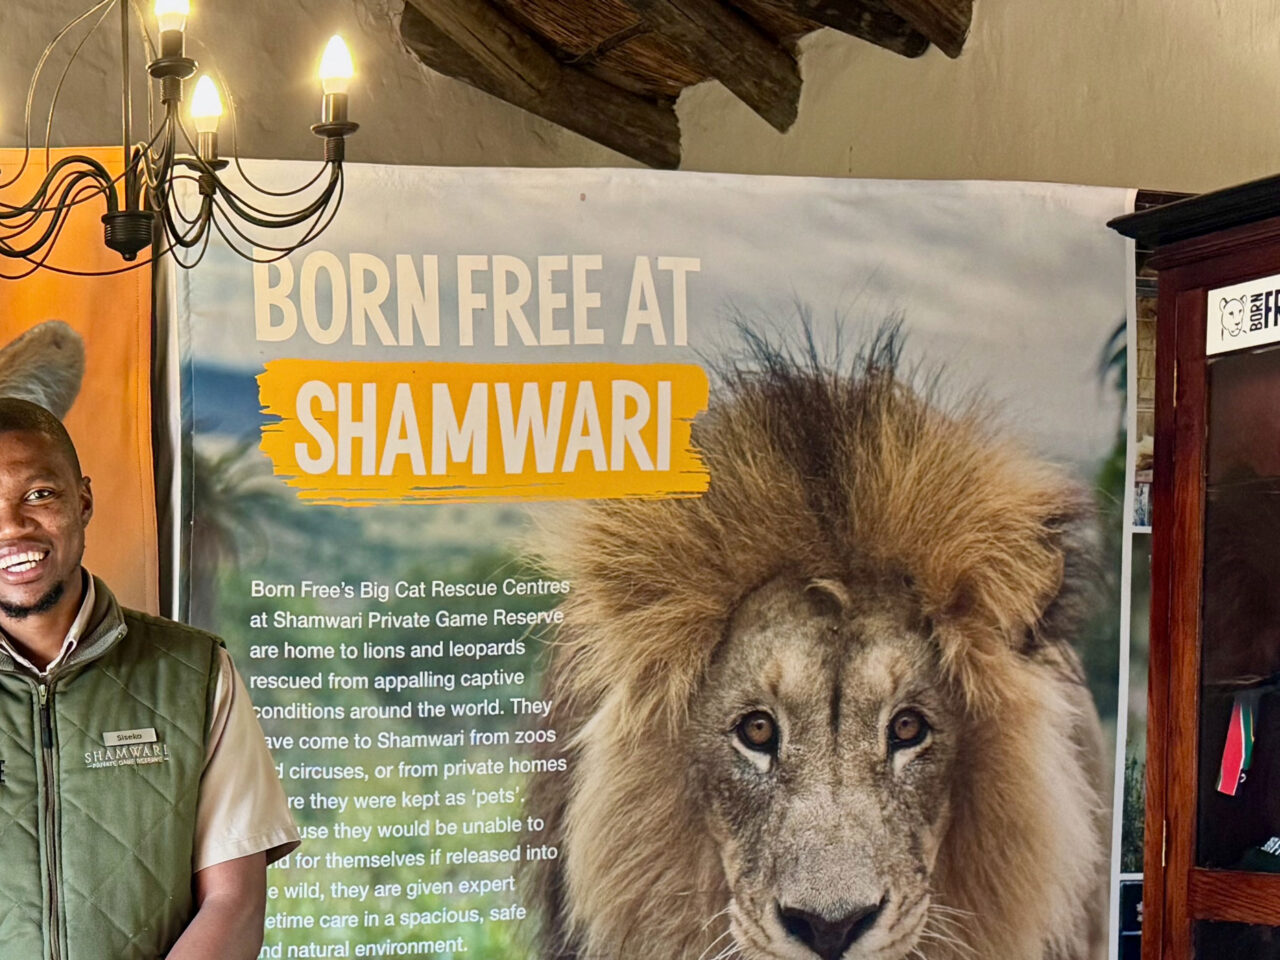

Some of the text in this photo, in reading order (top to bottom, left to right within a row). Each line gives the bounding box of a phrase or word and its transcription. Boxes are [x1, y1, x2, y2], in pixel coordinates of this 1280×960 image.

[253, 248, 701, 346] BORN FREE AT
[1250, 293, 1263, 332] BORN
[295, 380, 671, 476] SHAMWARI
[251, 578, 571, 602] Born Free's Big Cat Rescue Centres
[249, 608, 566, 629] at Shamwari Private Game Reserve
[249, 638, 526, 660] are home to lions and leopards
[250, 668, 525, 693] rescued from appalling captive
[349, 701, 412, 719] around
[416, 700, 446, 718] the
[450, 698, 504, 716] world.
[509, 697, 553, 717] They
[264, 728, 556, 749] ave come to Shamwari from zoos
[85, 744, 168, 764] SHAMWARI
[289, 762, 369, 782] circuses,
[374, 765, 394, 778] or
[397, 761, 438, 778] from
[443, 758, 504, 780] private
[509, 756, 567, 773] homes
[265, 903, 527, 929] etime care in a spacious, safe
[259, 936, 468, 959] nd natural environment.
